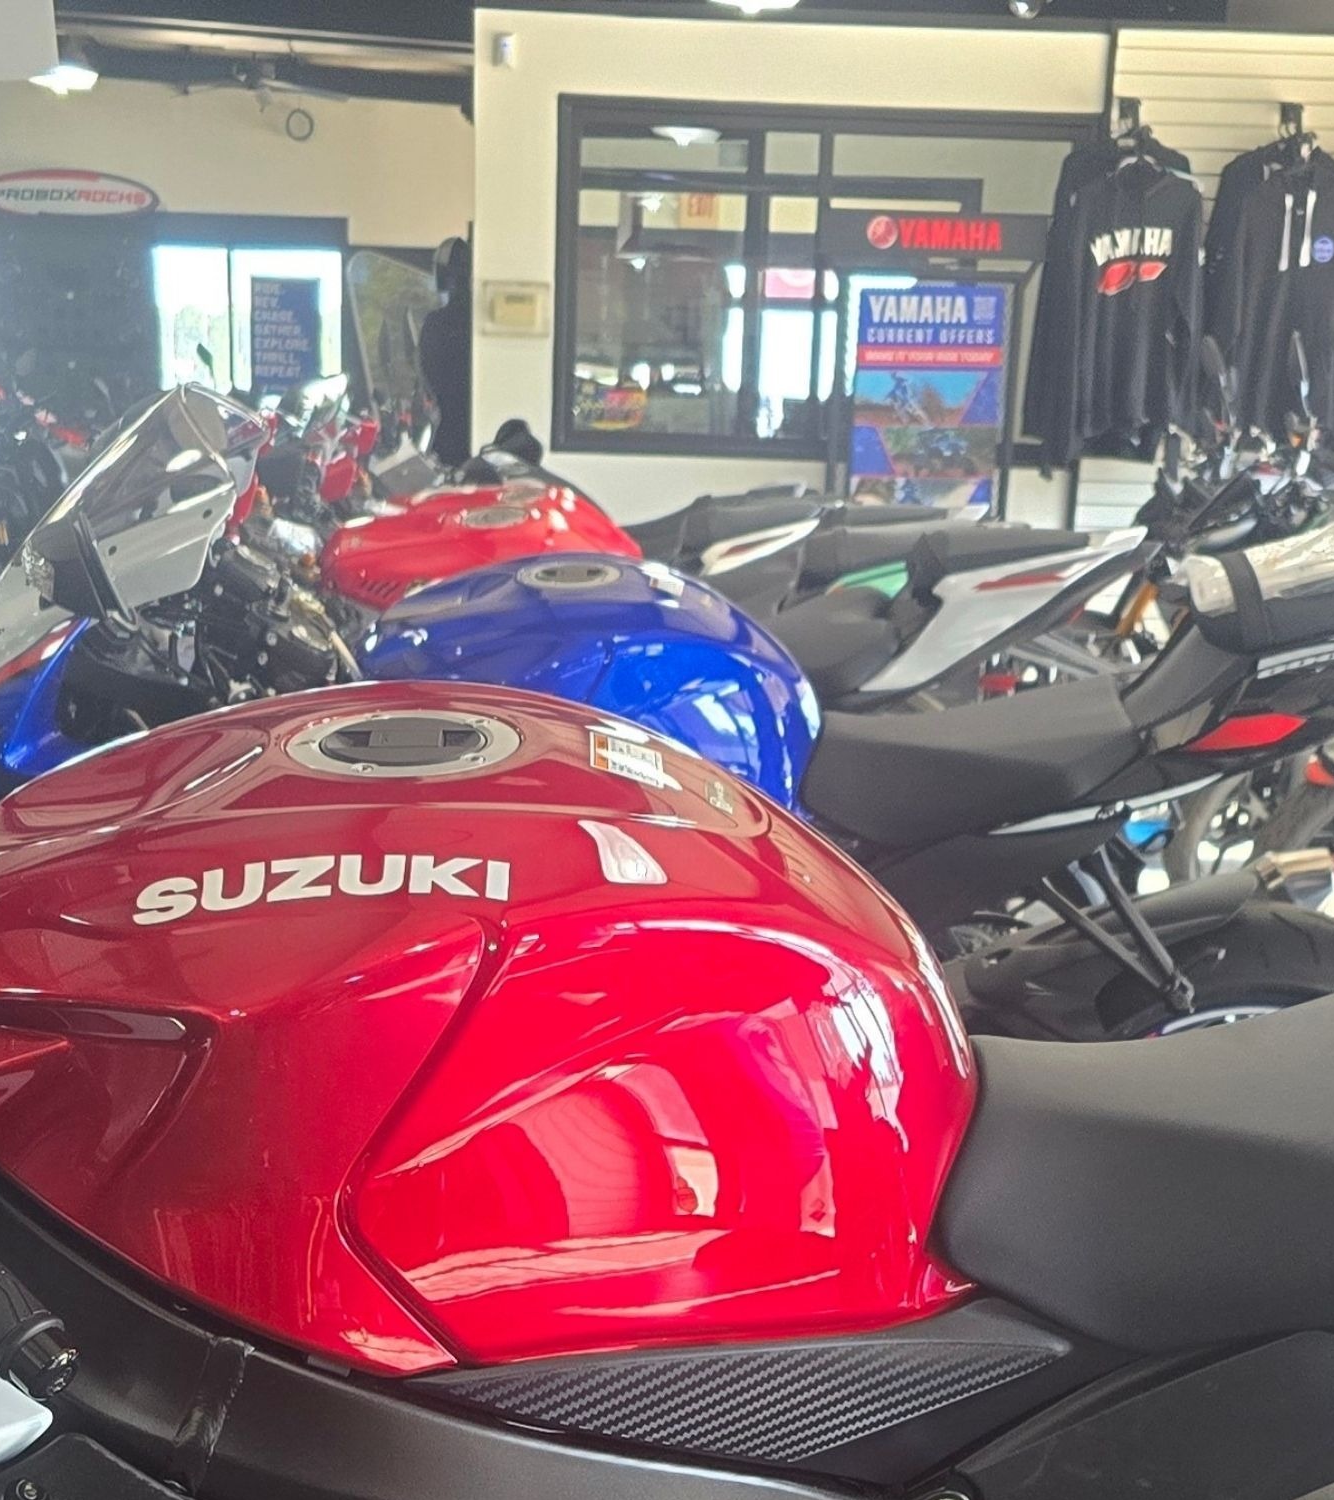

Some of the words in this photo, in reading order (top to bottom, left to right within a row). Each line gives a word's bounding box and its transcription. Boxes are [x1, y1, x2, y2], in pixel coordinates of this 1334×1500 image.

[899, 218, 1002, 250] YAMAHA
[869, 295, 967, 324] YAMAHA
[867, 328, 934, 344] CURRENT
[939, 328, 995, 345] OFFERS
[133, 854, 510, 926] SUZUKI
